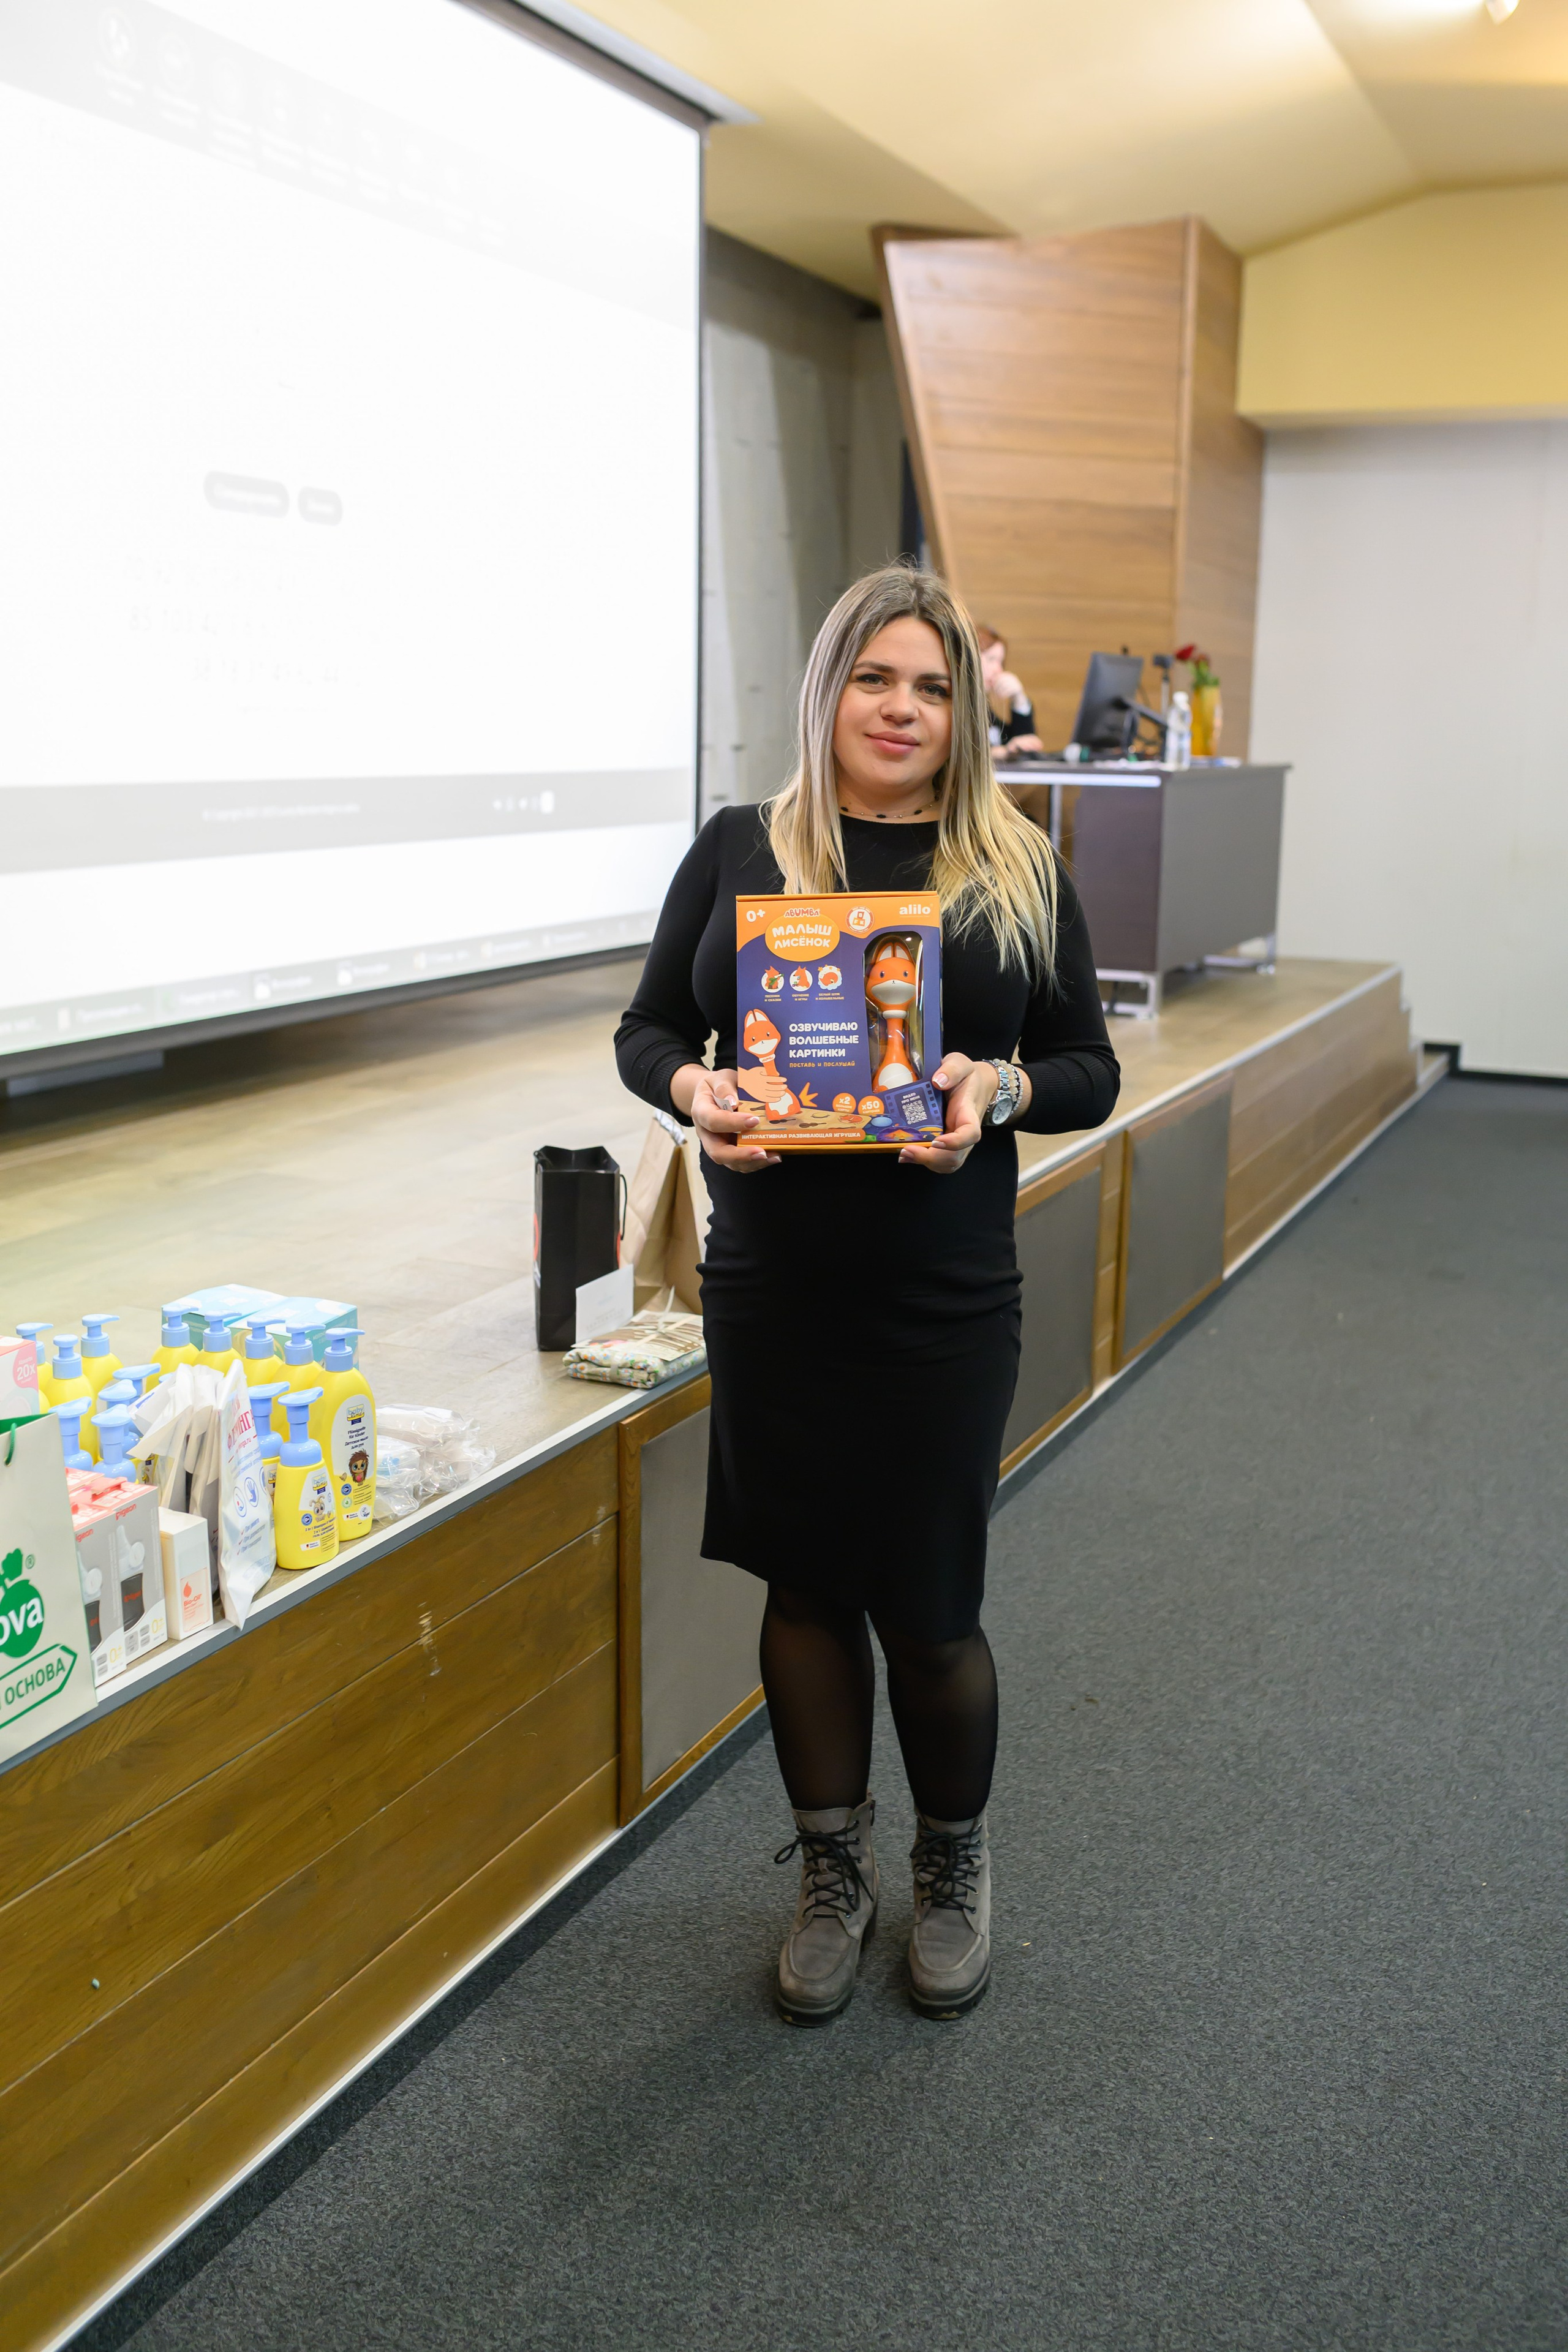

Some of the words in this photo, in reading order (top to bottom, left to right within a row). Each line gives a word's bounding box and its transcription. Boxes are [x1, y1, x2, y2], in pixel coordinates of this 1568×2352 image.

[746, 909, 766, 922] 0+
[899, 904, 931, 914] alilo
[772, 924, 832, 938] МАЛЫШ
[774, 935, 831, 949] ЛИСЁНОК
[789, 1022, 858, 1032] ОЗВУЧИВАЮ
[789, 1035, 859, 1046] ВОЛШЕБНЫЕ
[789, 1048, 846, 1058] КАРТИНКИ
[17, 1363, 36, 1381] 20x
[75, 1529, 93, 1543] igeon
[5, 1657, 66, 1705] ОСНОВА
